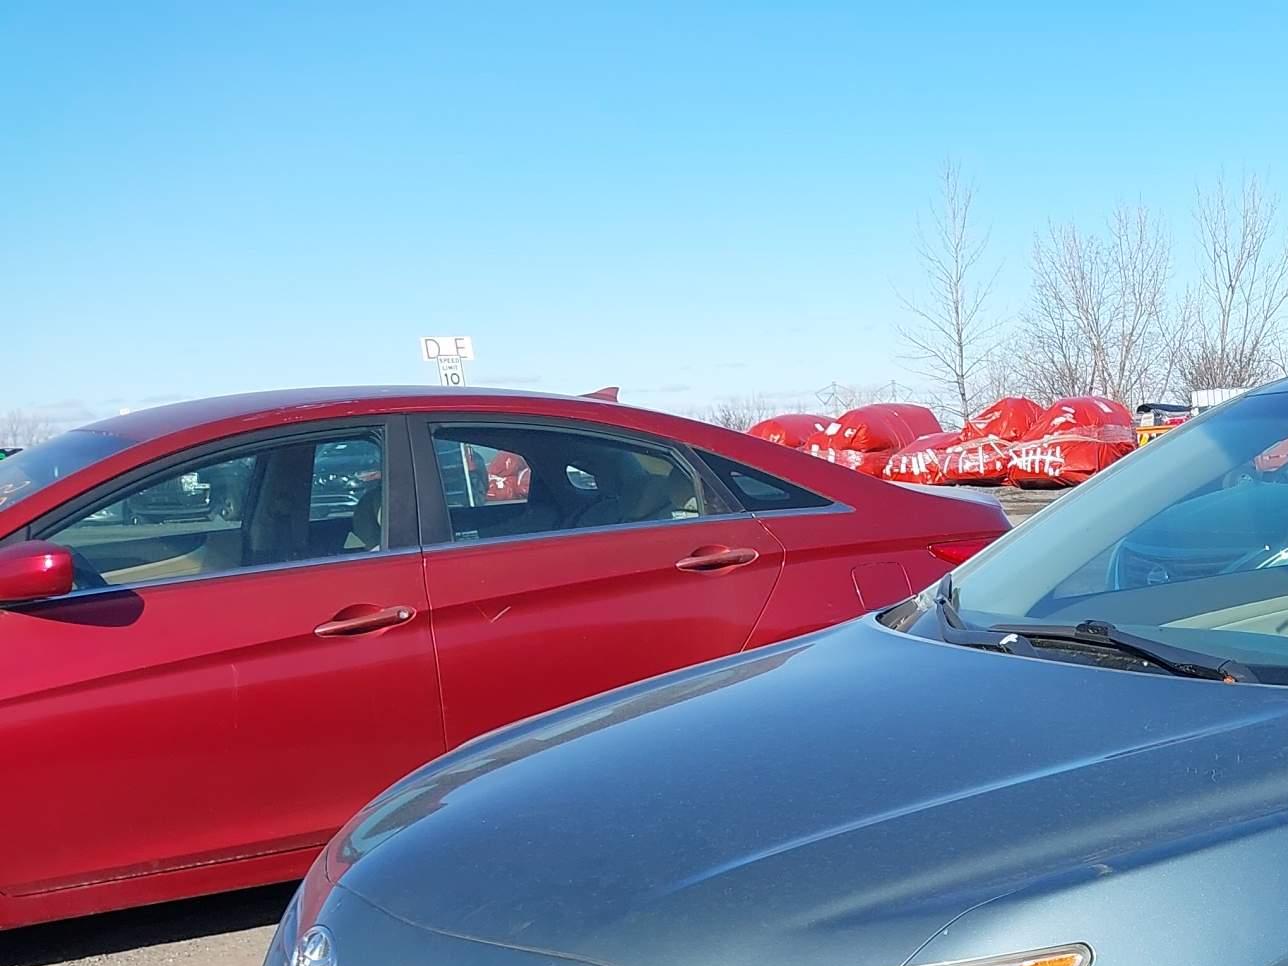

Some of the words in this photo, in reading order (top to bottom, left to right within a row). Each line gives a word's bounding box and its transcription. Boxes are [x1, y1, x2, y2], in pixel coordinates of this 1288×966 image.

[424, 338, 440, 359] D
[454, 337, 468, 359] E
[444, 372, 460, 386] 10
